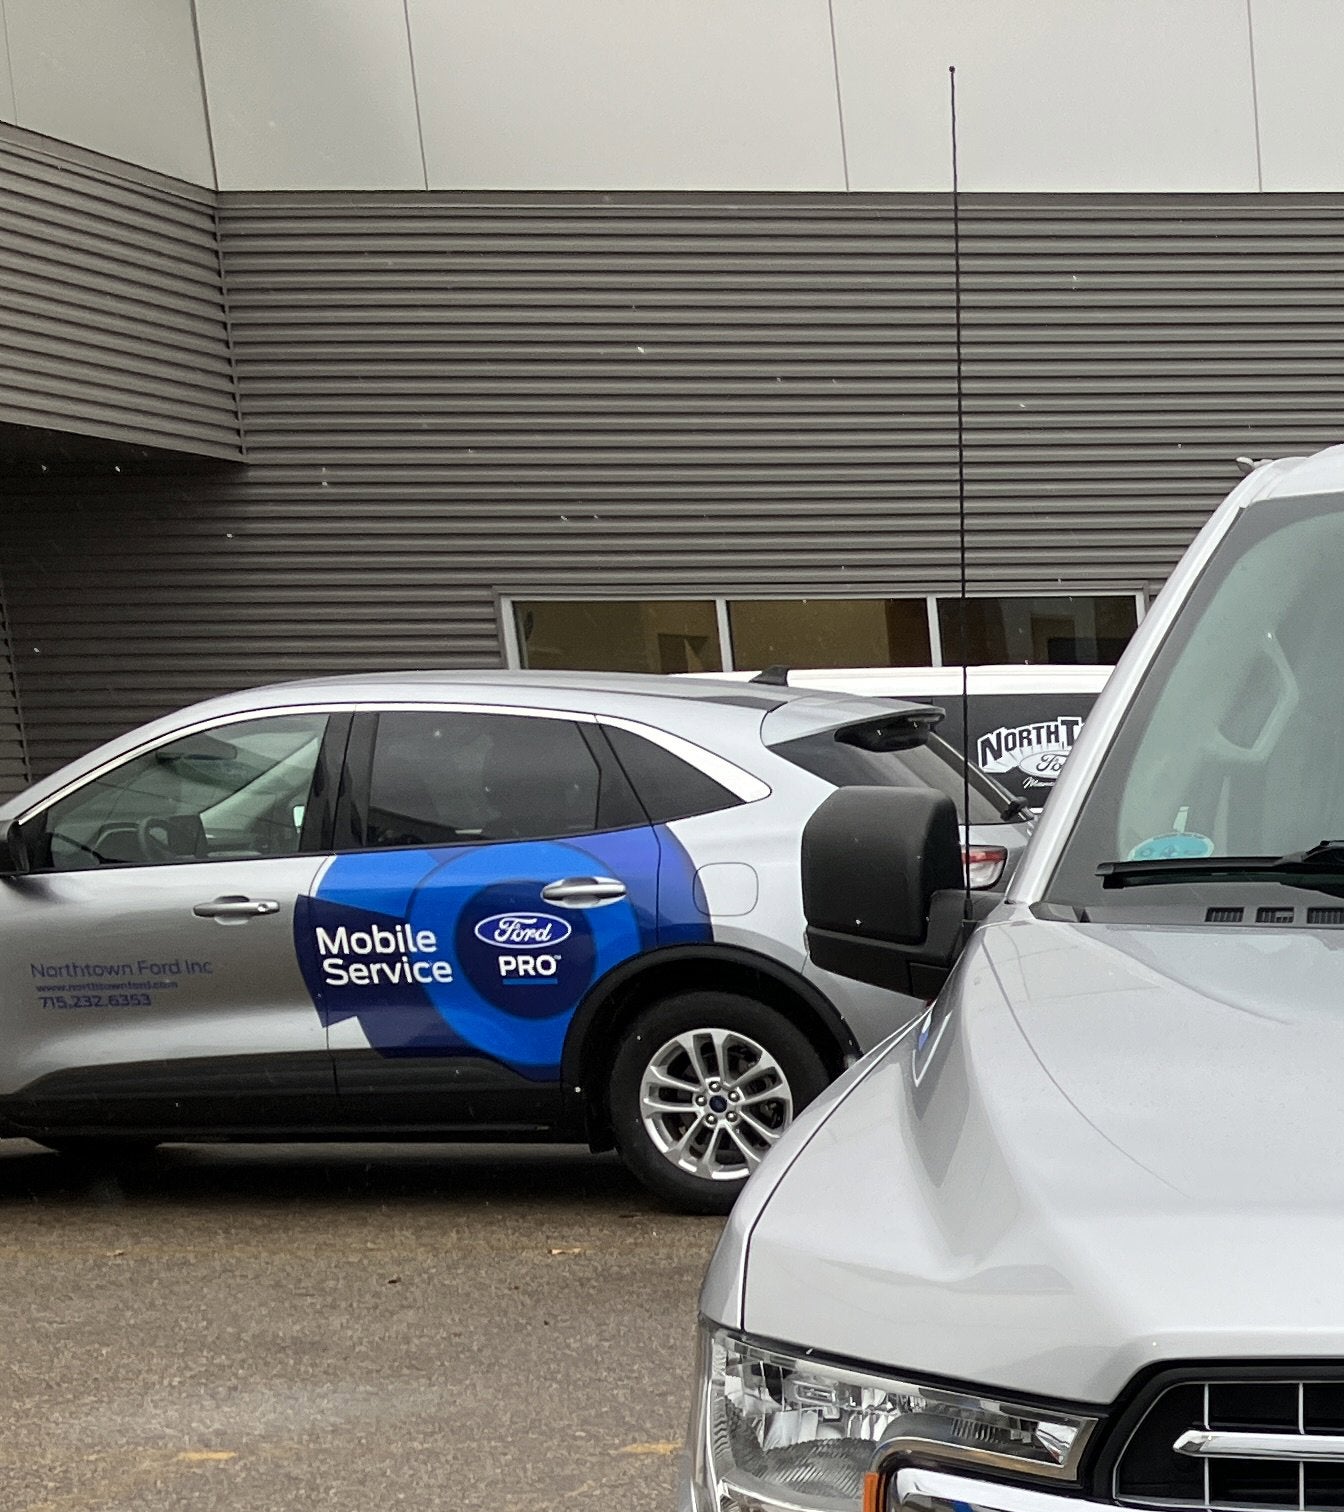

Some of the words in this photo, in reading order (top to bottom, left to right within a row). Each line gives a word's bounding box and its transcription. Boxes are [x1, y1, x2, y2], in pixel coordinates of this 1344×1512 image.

[980, 719, 1082, 768] NORTHT
[315, 923, 437, 956] Mobile
[493, 917, 553, 943] Ford
[31, 962, 133, 978] Northtown
[137, 960, 181, 976] Ford
[185, 959, 213, 975] Inc
[322, 956, 454, 986] Service
